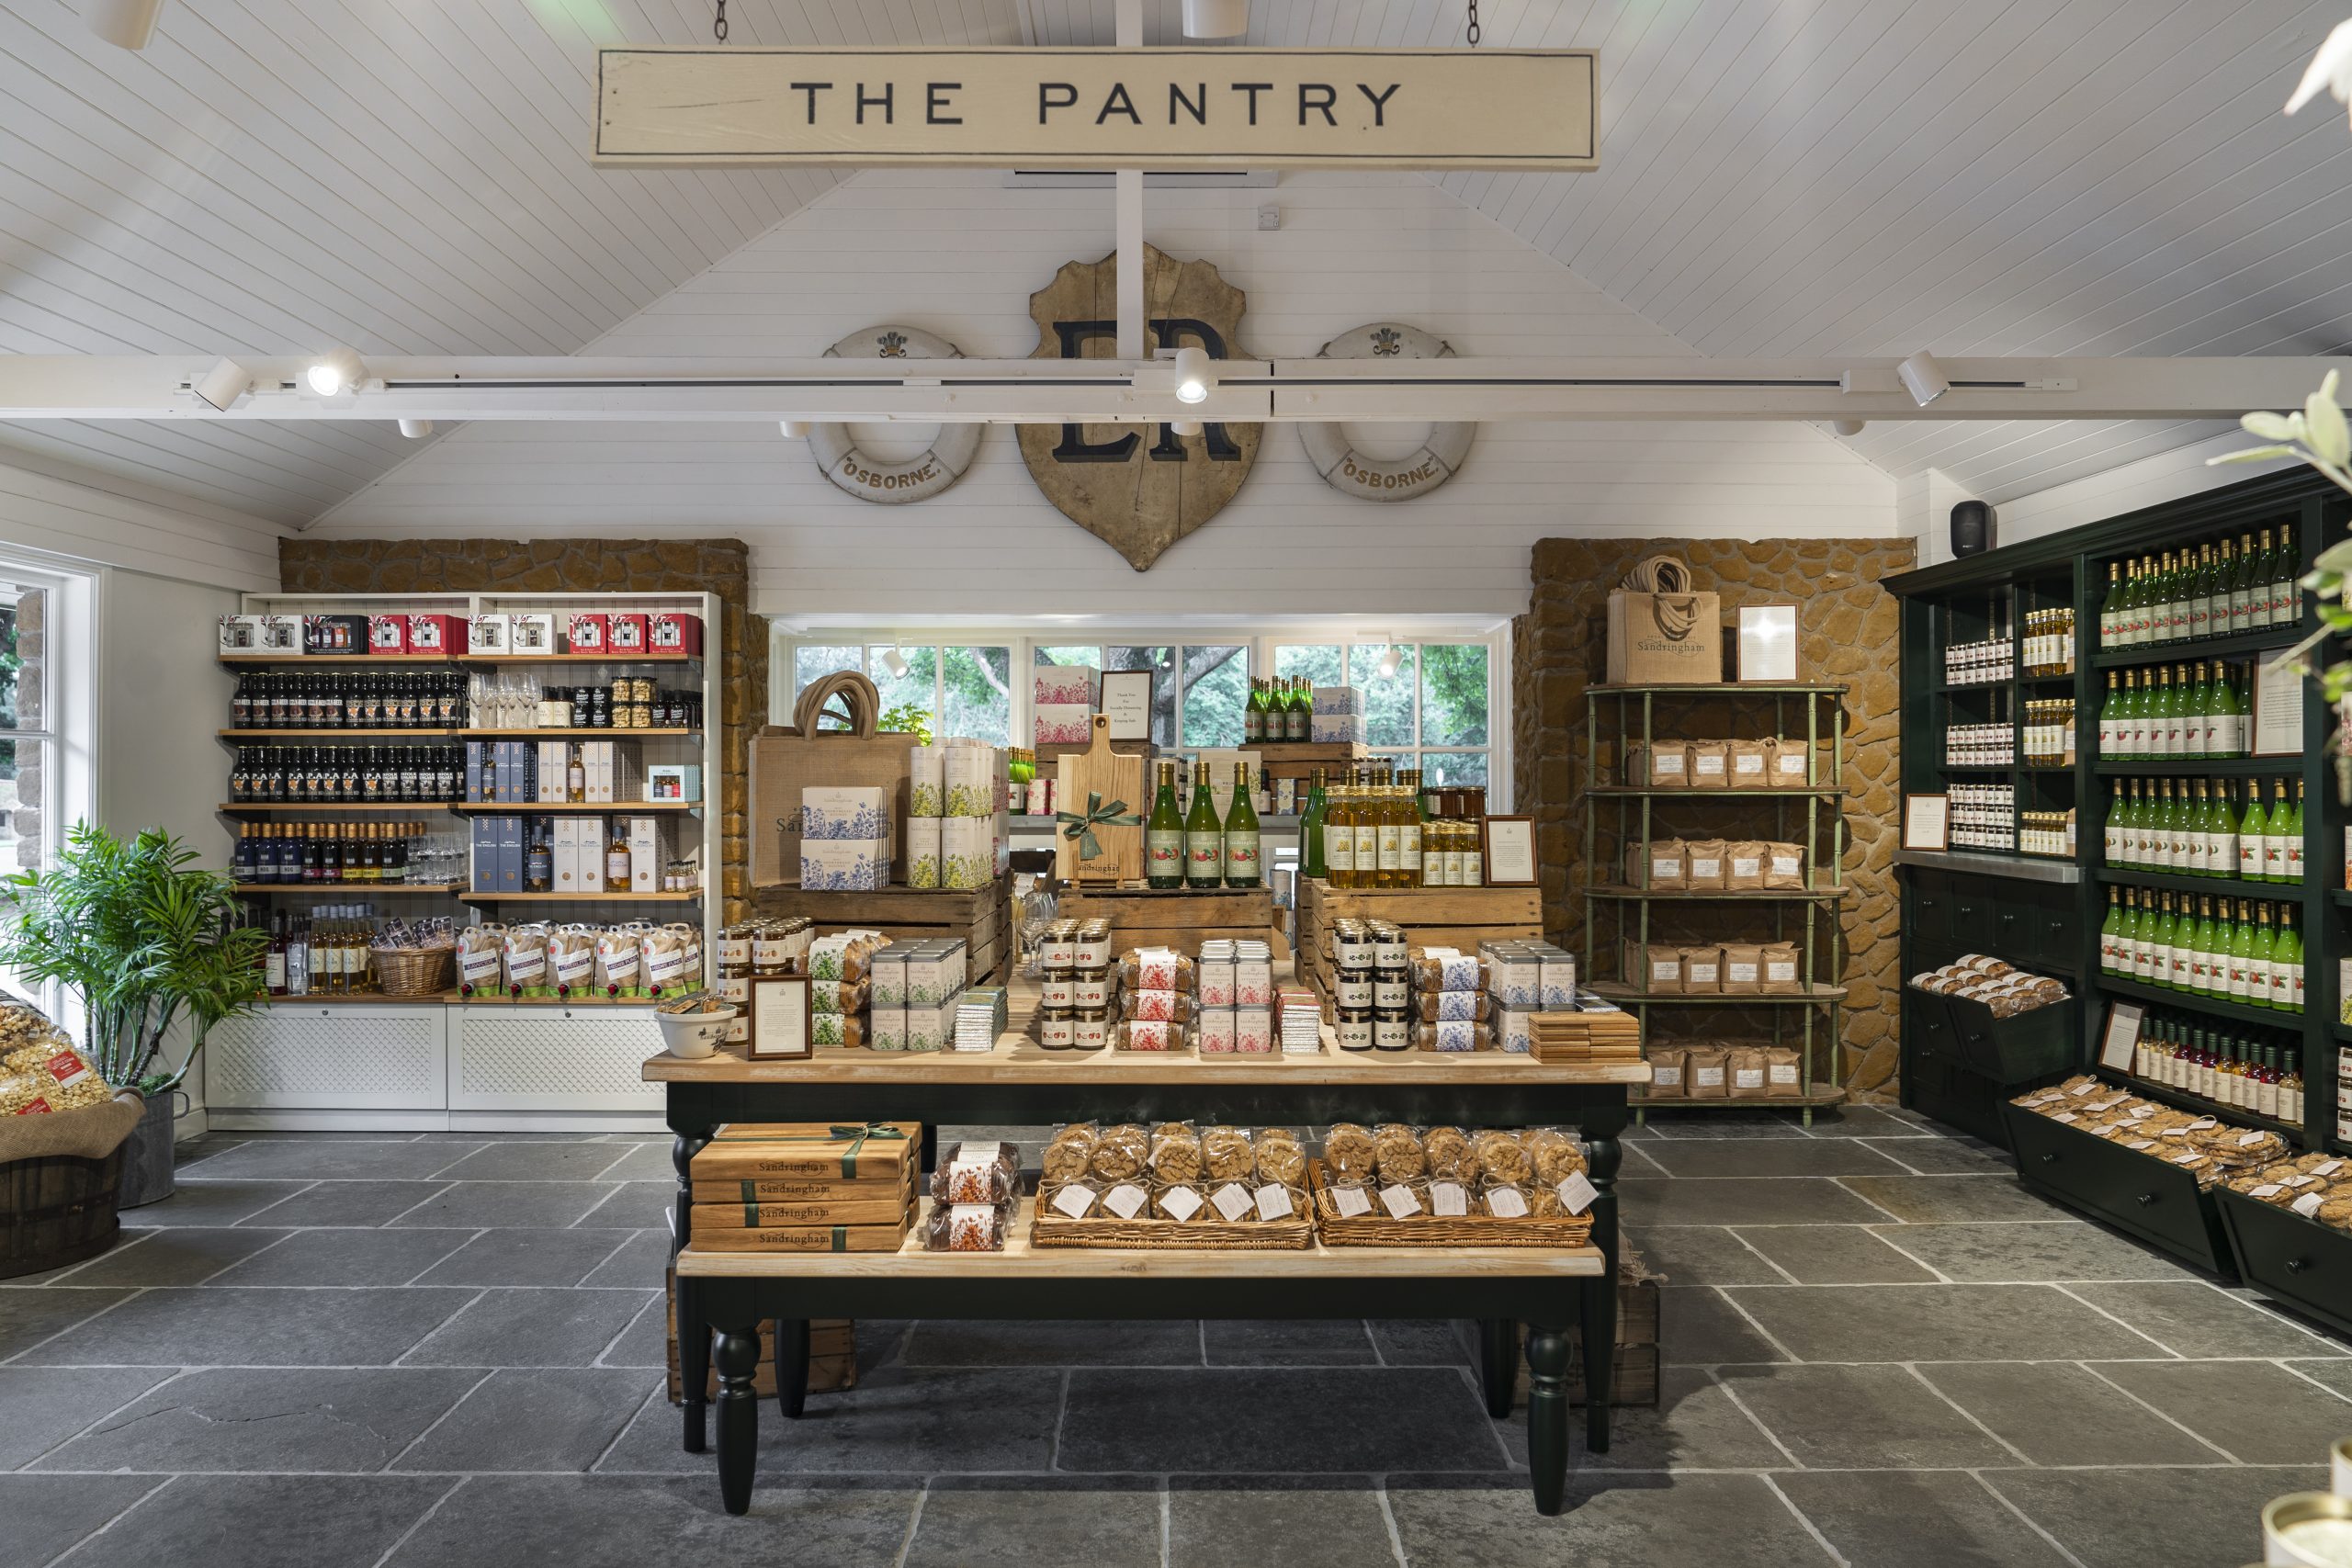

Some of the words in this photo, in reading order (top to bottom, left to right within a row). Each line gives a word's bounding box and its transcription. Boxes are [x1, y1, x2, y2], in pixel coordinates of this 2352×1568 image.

[791, 82, 964, 126] THE
[1039, 82, 1403, 127] PANTRY
[1637, 639, 1705, 654] Sandringham
[759, 1161, 829, 1173] Sandringham
[760, 1183, 830, 1195] Sandringham
[759, 1207, 830, 1219] Sandringham
[759, 1232, 829, 1245] Sandringham
